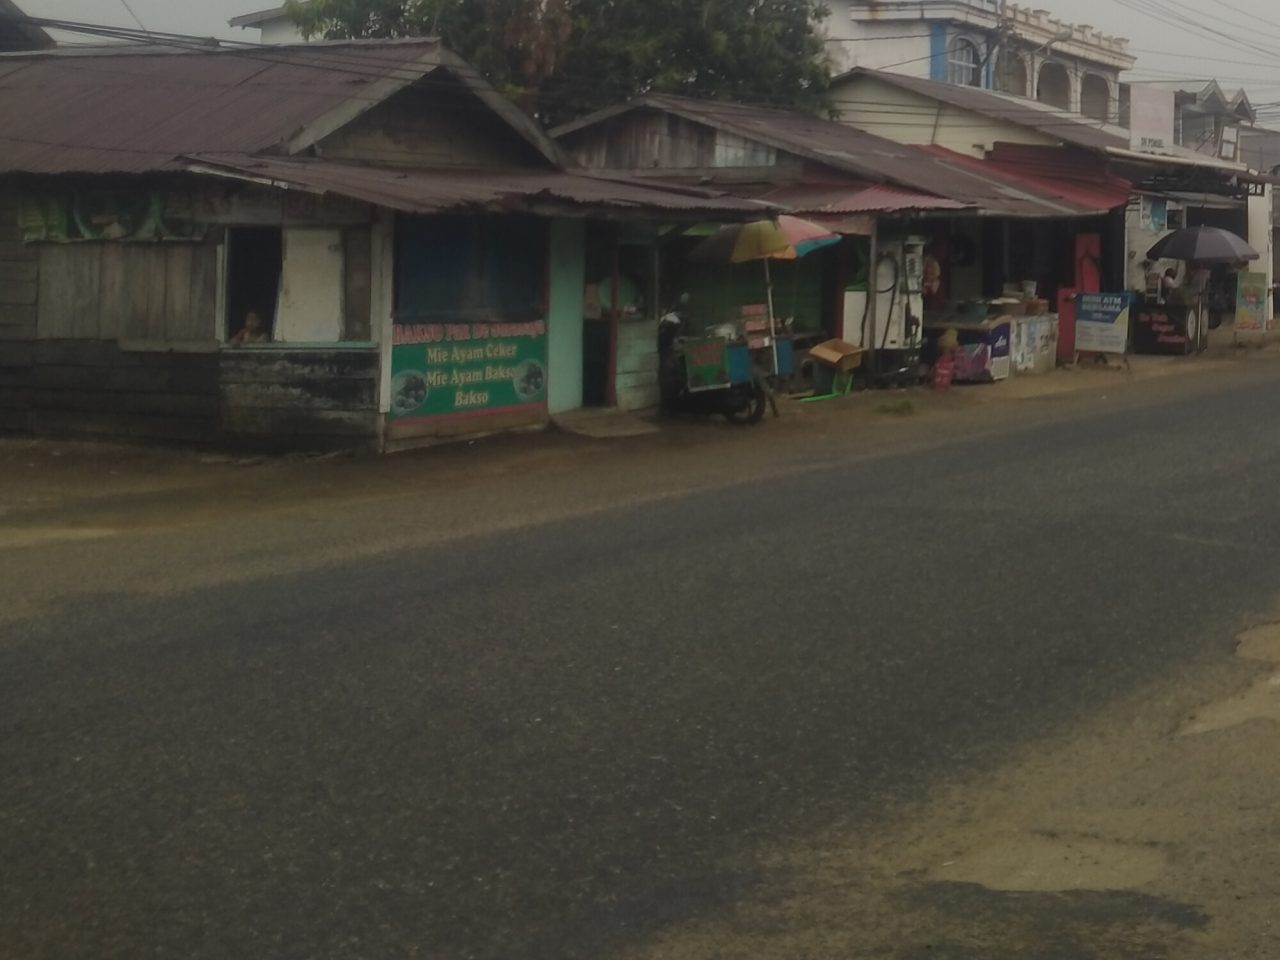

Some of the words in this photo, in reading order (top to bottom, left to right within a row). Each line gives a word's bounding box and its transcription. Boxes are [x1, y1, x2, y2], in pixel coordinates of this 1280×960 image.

[1103, 296, 1122, 304] ATM
[427, 347, 449, 364] Mie
[450, 346, 483, 364] Ayam
[485, 343, 518, 358] Ceker
[426, 371, 449, 387] Mie
[450, 369, 483, 386] Ayam
[455, 391, 489, 407] Bakso
